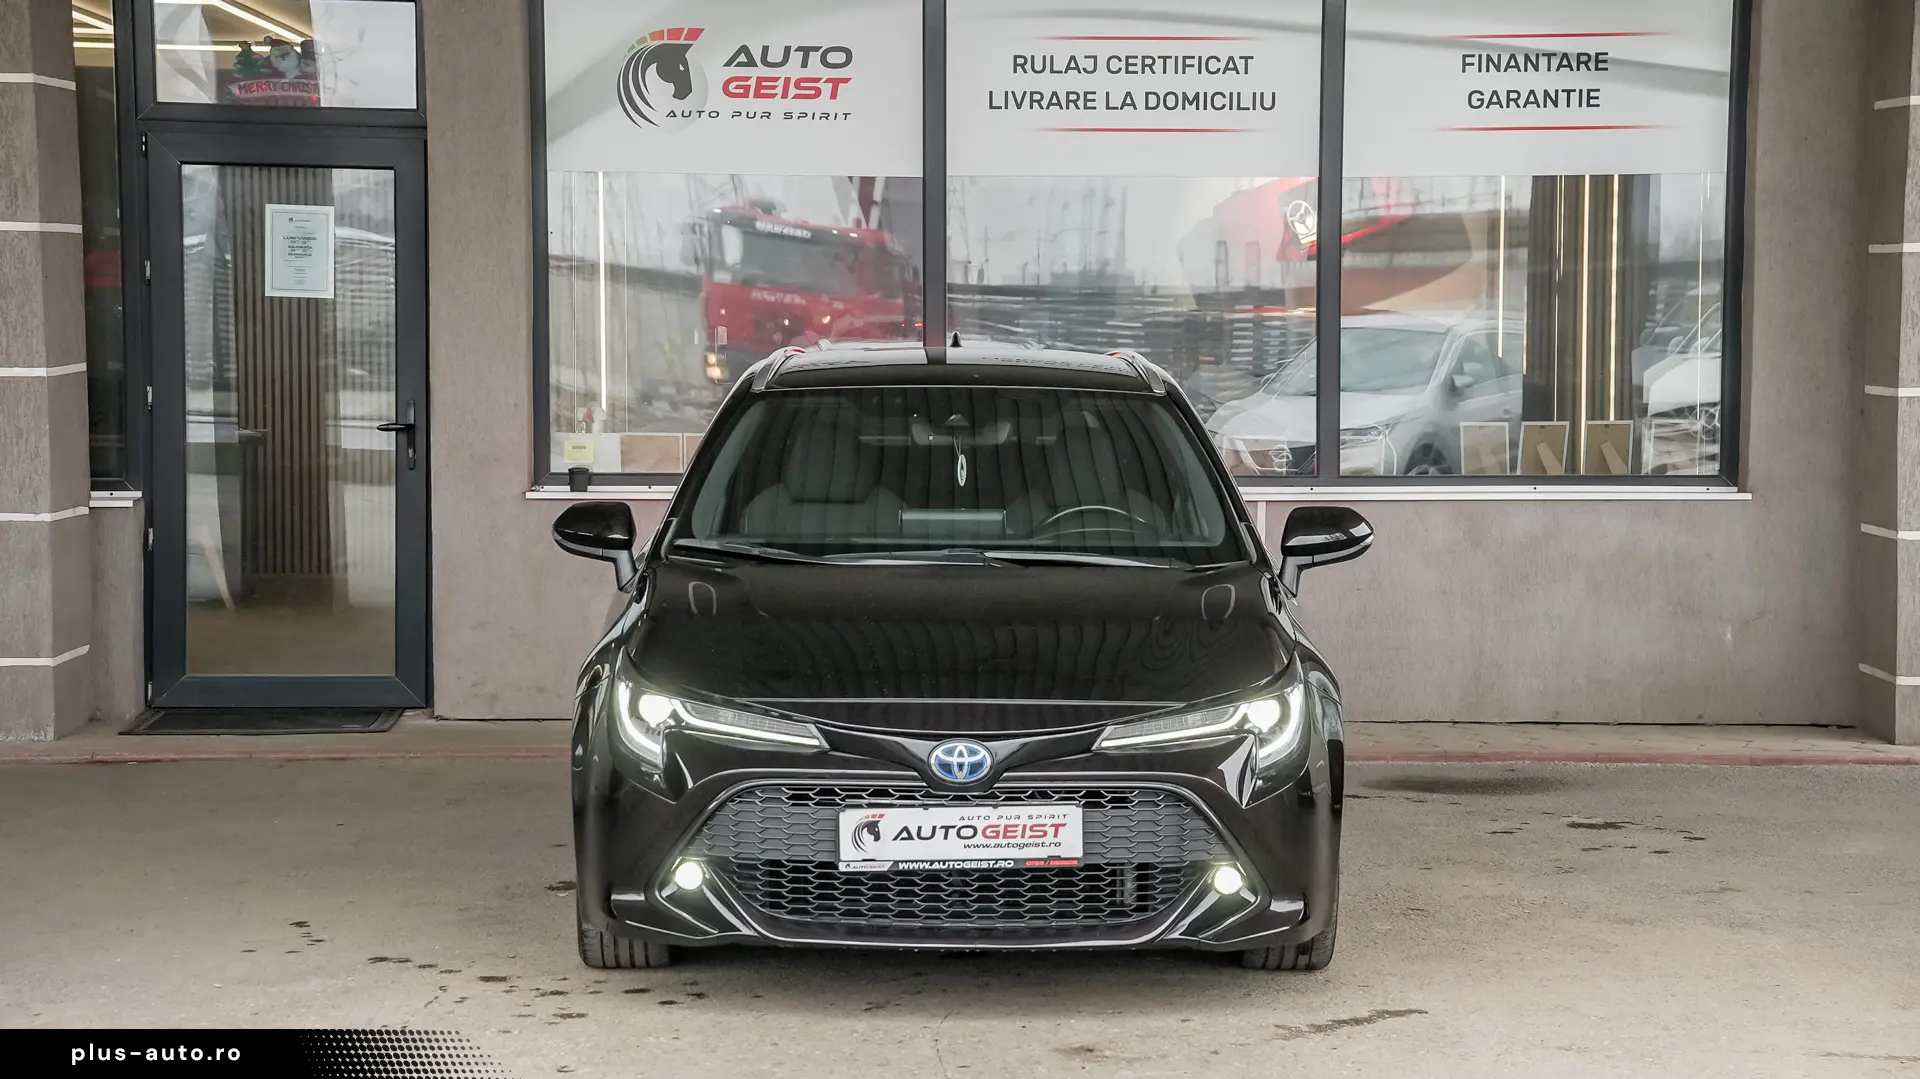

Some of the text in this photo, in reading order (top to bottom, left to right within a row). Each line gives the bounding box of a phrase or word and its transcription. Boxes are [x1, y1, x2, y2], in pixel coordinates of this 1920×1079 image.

[723, 45, 853, 69] AUTO
[1012, 55, 1255, 75] RULAJ CERTIFICAT
[1461, 52, 1609, 74] FINANTARE
[238, 81, 278, 94] MERRY
[722, 76, 853, 101] GEIST
[988, 91, 1276, 112] LIVRARE LA DOMICILIU
[1467, 88, 1601, 110] GARANTIE
[665, 110, 852, 121] AUTO PUR SPIRIT
[963, 841, 1062, 850] www.autogeist.ro
[898, 860, 1015, 869] WWW.AUTOGEIST.RO
